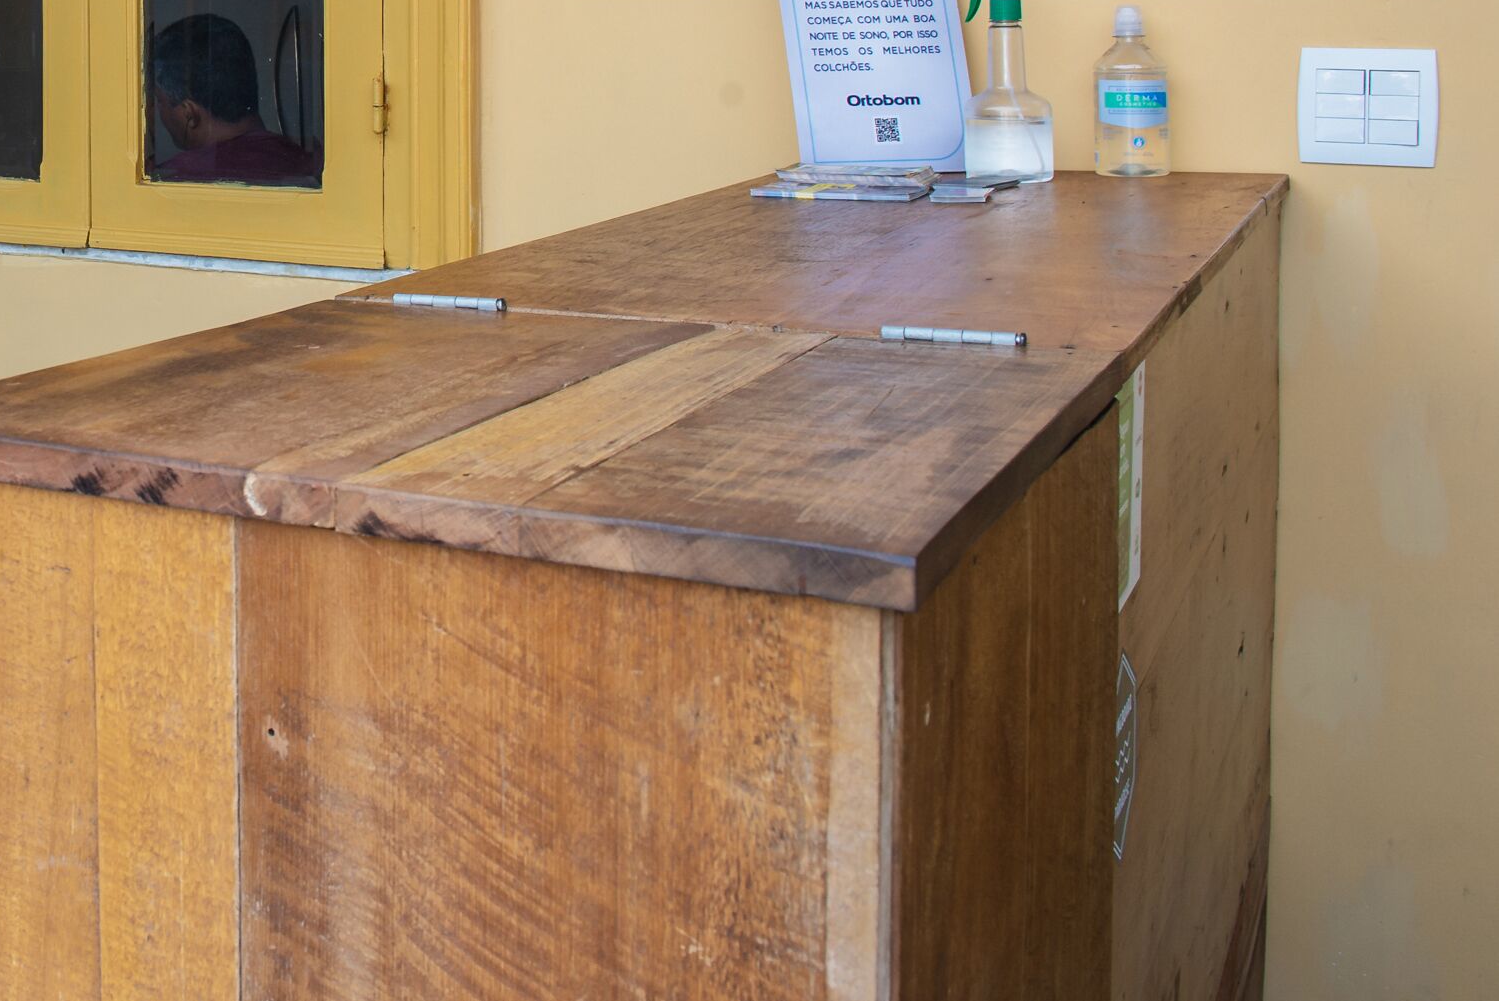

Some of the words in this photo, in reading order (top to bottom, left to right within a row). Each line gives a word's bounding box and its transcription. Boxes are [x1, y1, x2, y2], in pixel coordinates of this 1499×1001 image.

[805, 1, 827, 10] MAS
[828, 0, 879, 9] SABEMOS
[880, 0, 902, 9] QUE
[904, 0, 933, 8] TUDO
[807, 16, 852, 26] COMEÇA
[857, 16, 881, 25] COM
[885, 15, 908, 24] UMA
[913, 15, 936, 23] BOA
[809, 32, 838, 41] NOITE
[842, 31, 856, 40] DE
[859, 31, 890, 41] SONO,
[893, 30, 913, 39] POR
[917, 30, 938, 38] ISSO
[811, 47, 849, 56] TEMOS
[858, 47, 873, 56] OS
[883, 45, 941, 55] MELHORES
[814, 61, 874, 72] COLCHÕES.
[847, 94, 920, 107] Ortobom
[1116, 94, 1158, 102] DERMA
